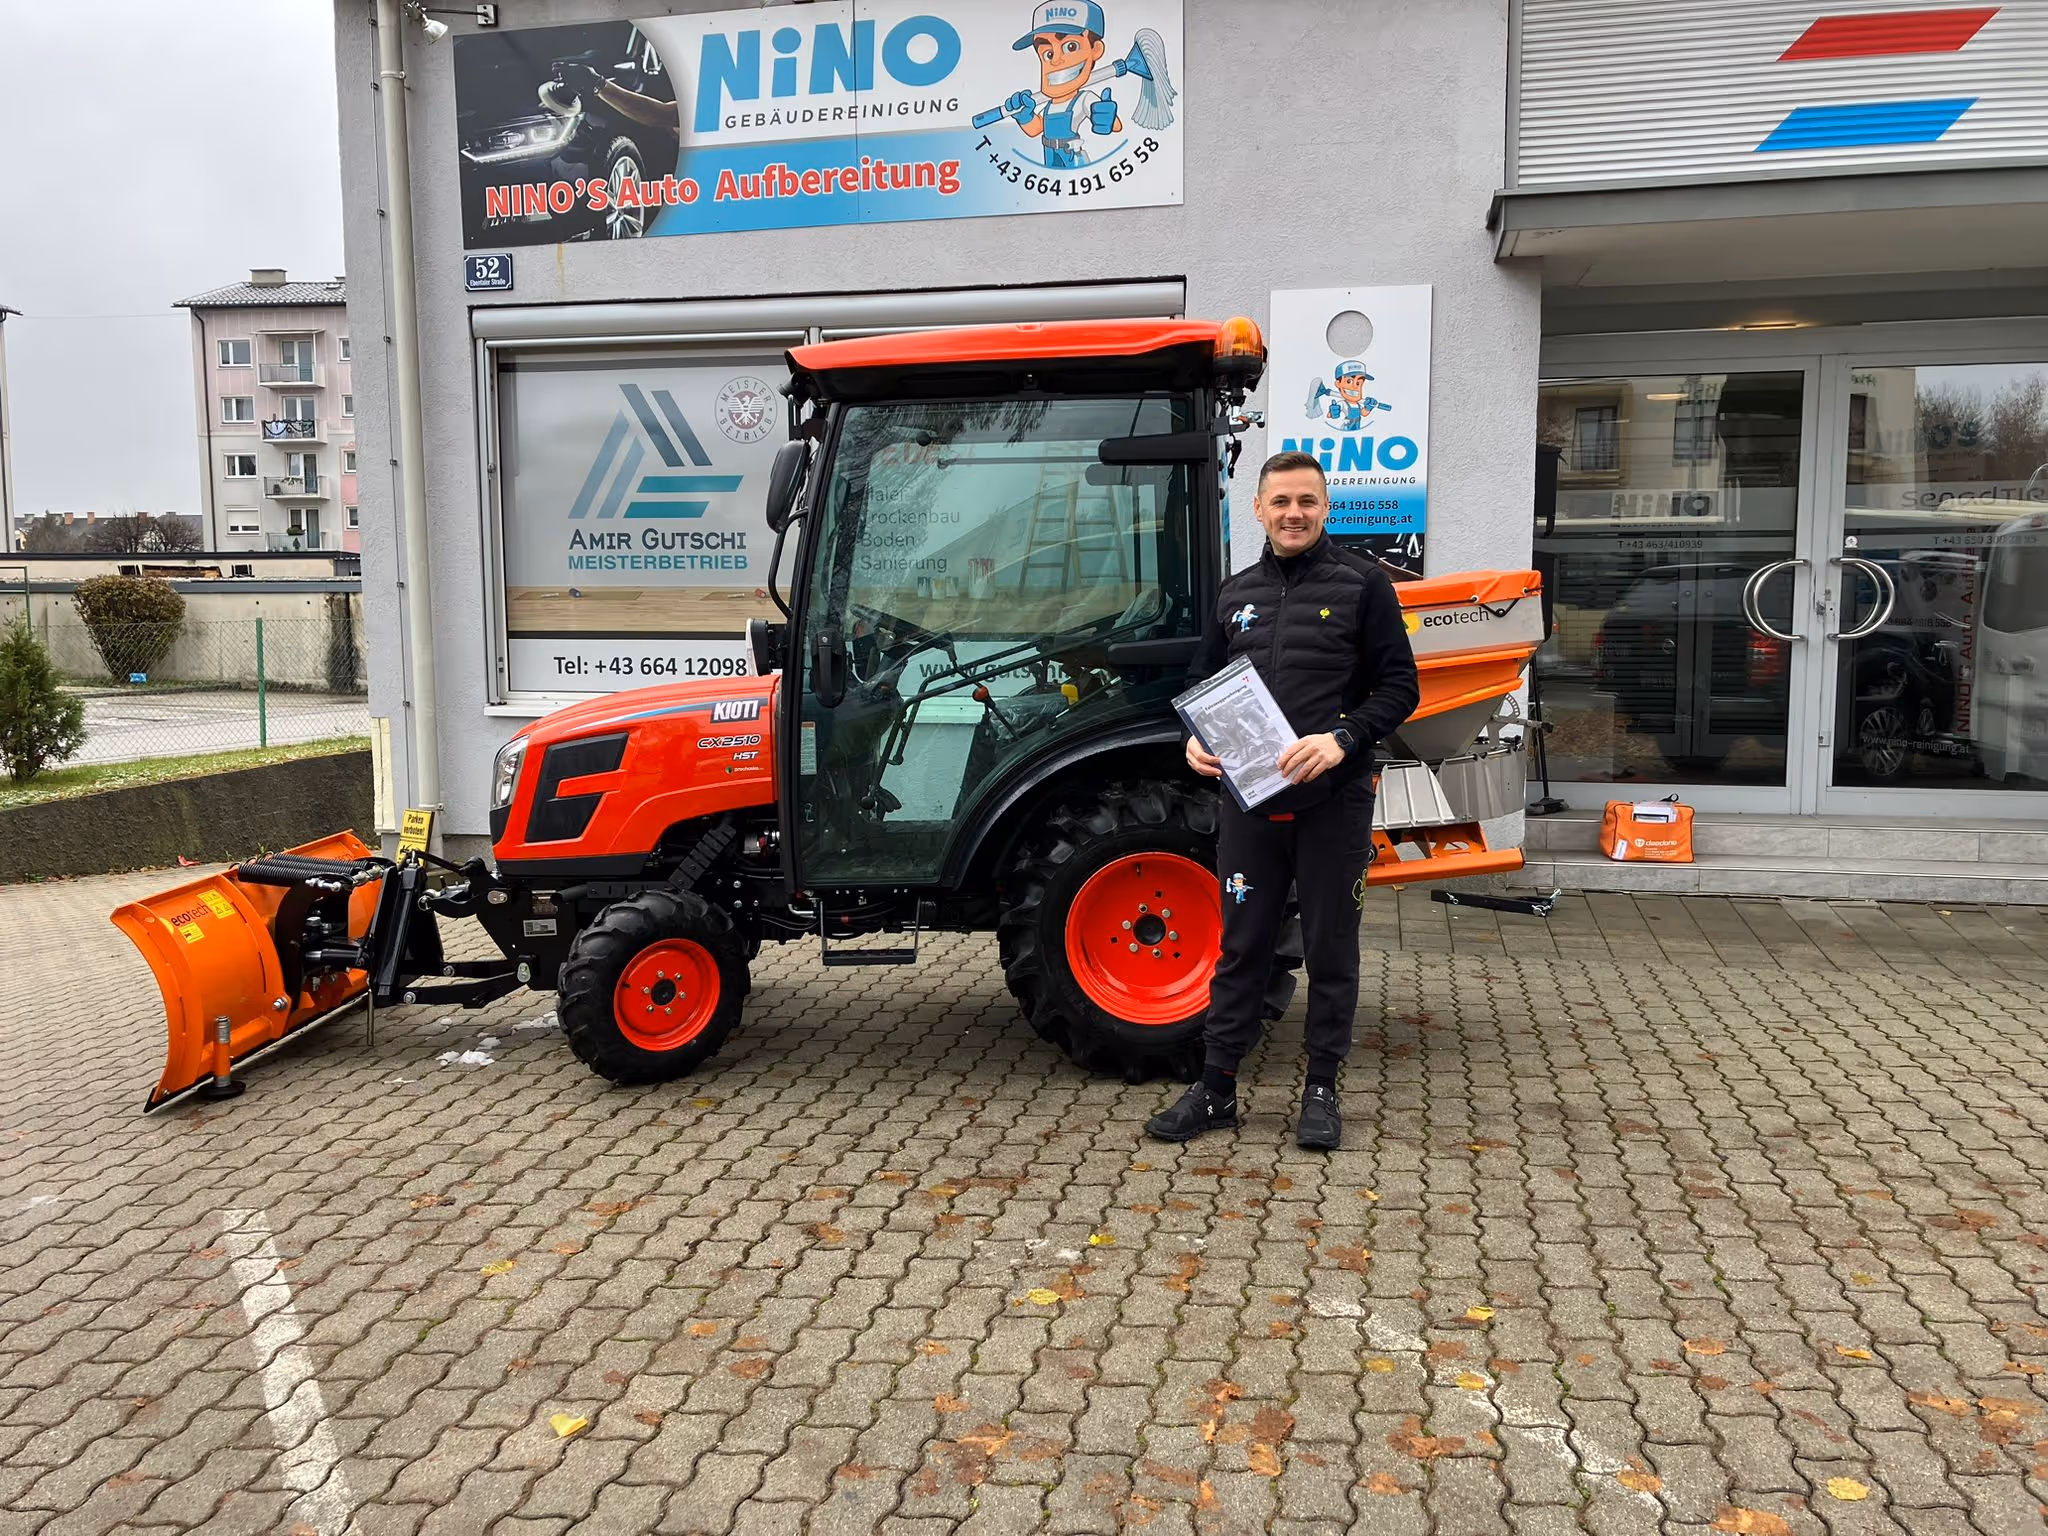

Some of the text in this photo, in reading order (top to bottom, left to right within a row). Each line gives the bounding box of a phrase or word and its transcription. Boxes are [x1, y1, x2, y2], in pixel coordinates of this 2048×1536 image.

[725, 98, 960, 129] GEBÄUDEREINIGUNG
[975, 135, 1159, 196] T +43 664 191 65 58
[485, 155, 961, 218] NINO'S Auto Aufbereitung
[475, 257, 499, 278] 52
[719, 379, 772, 403] MEISTER
[719, 417, 772, 441] BETRIEB
[1325, 476, 1416, 486] UDEREINIGUNG
[1349, 500, 1375, 511] 1916
[1378, 500, 1399, 510] 558
[568, 528, 747, 551] AMIR GUTSCHI
[861, 532, 915, 547] Boden
[568, 555, 748, 570] MEISTERBETRIEB
[861, 556, 948, 573] Sanierung
[1423, 607, 1489, 628] ecotech
[553, 656, 589, 675] Tel:
[595, 657, 634, 675] +43
[640, 656, 678, 675] 664
[713, 700, 759, 721] KIOTI
[698, 735, 760, 748] CX2510
[733, 752, 759, 760] HST
[171, 903, 211, 927] ecotech
